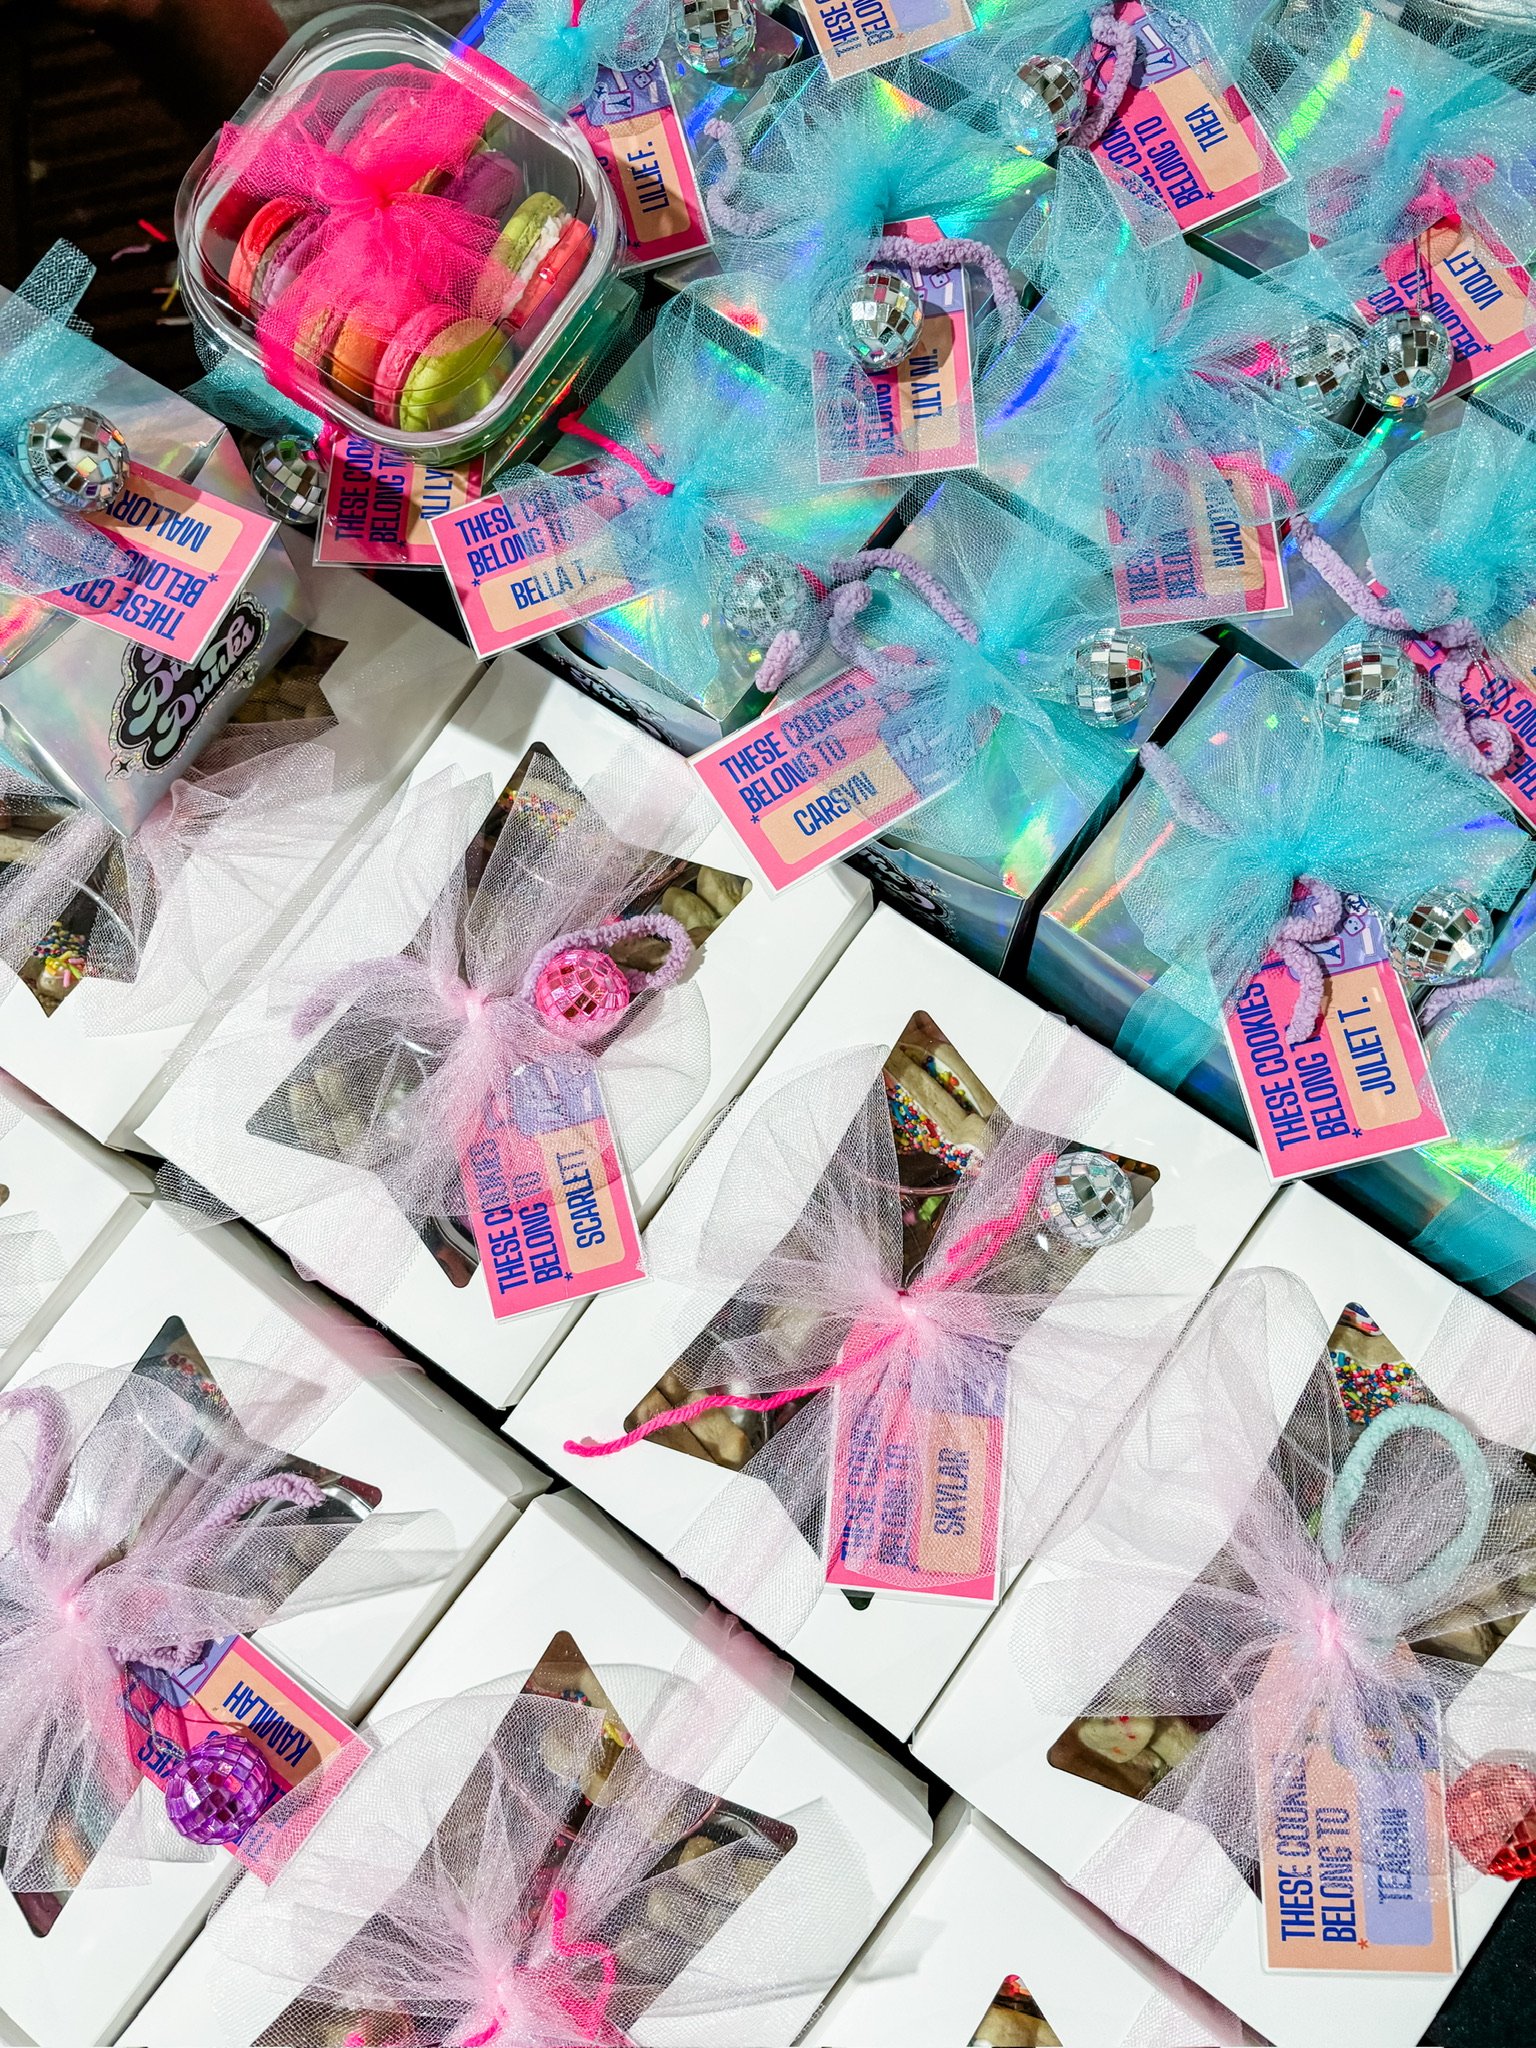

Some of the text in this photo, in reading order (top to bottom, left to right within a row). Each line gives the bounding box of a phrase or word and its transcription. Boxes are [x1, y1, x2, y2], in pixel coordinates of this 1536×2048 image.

[819, 3, 862, 57] THESE
[1133, 115, 1205, 209] BELONG TO
[1185, 102, 1228, 153] THEA
[627, 141, 670, 213] LILLIE F.
[1398, 268, 1433, 299] TO
[1443, 250, 1504, 311] VIOLET
[909, 348, 942, 420] LILY M.
[335, 487, 370, 541] THESE
[369, 474, 405, 544] BELONG
[466, 527, 545, 577] BELONG
[510, 565, 573, 610] BELLA
[109, 588, 186, 641] THESE
[719, 682, 867, 784] THESE COOKIES
[737, 733, 847, 814] BELONG TO
[792, 770, 879, 837] CARSYN
[1236, 982, 1310, 1152] THESE COOKIES
[1338, 995, 1397, 1095] JULIET T.
[1294, 1051, 1351, 1141] BELONG
[469, 1138, 528, 1294] THESE COOKIES
[511, 1170, 563, 1285] BELONG TO
[556, 1149, 606, 1248] SCARLETT
[933, 1447, 970, 1537] SKYLAR
[222, 1680, 312, 1768] KAMILAH
[1277, 1864, 1316, 1942] THESE
[1315, 1806, 1357, 1943] BELONG TO
